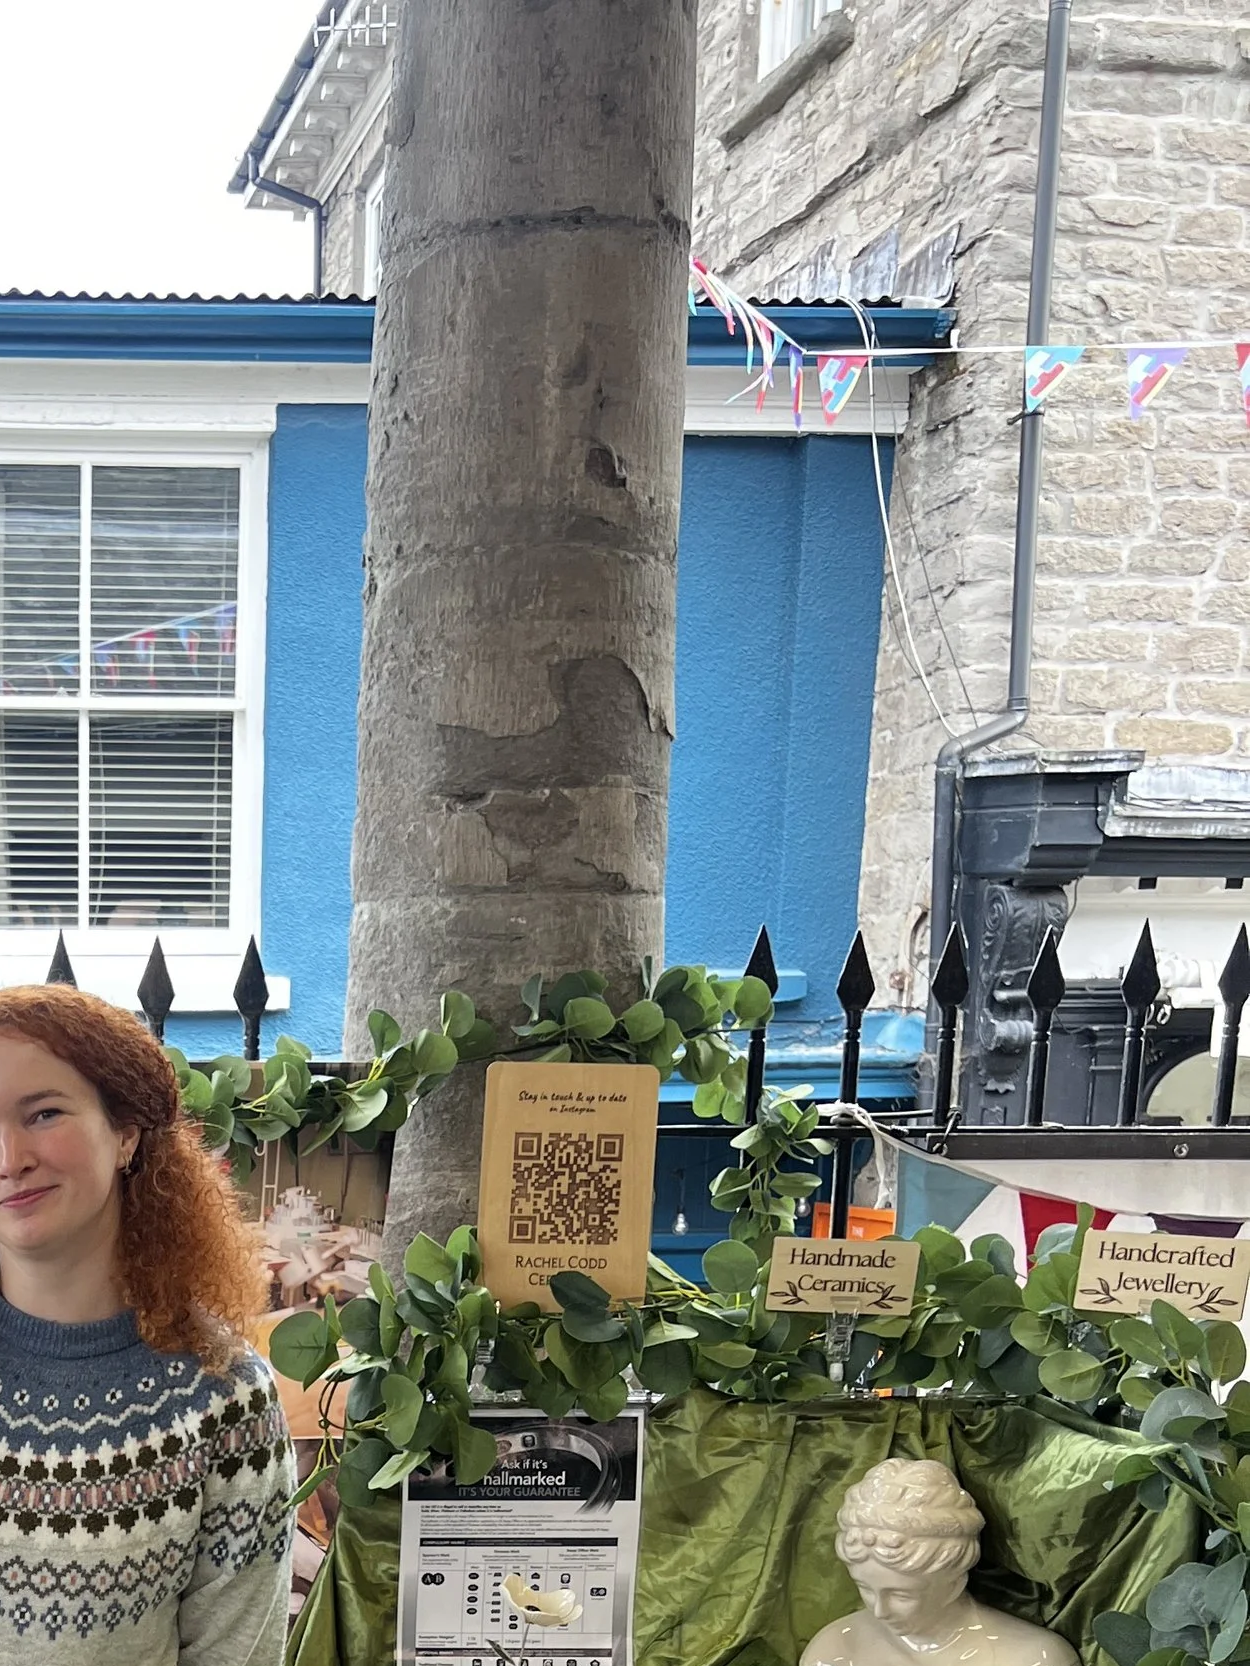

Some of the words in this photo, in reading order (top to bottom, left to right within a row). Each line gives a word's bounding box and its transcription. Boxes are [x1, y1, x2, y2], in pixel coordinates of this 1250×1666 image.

[518, 1090, 538, 1104] Stay
[540, 1091, 548, 1101] in
[551, 1092, 573, 1102] touch
[575, 1092, 584, 1102] &
[586, 1095, 595, 1104] up
[598, 1093, 607, 1103] to
[609, 1093, 627, 1103] date
[559, 1104, 597, 1115] Instagram
[789, 1247, 896, 1269] Handmade
[1098, 1241, 1236, 1268] Handcrafted
[514, 1255, 565, 1269] RACHEL
[567, 1255, 608, 1269] CODD
[797, 1273, 886, 1294] Ceramics
[1112, 1271, 1211, 1300] Jewellery
[501, 1459, 520, 1471] Ask
[522, 1459, 531, 1470] if
[532, 1459, 548, 1470] it's
[458, 1486, 477, 1497] IT'S
[479, 1486, 511, 1497] YOUR
[513, 1486, 581, 1497] GUARANTEE
